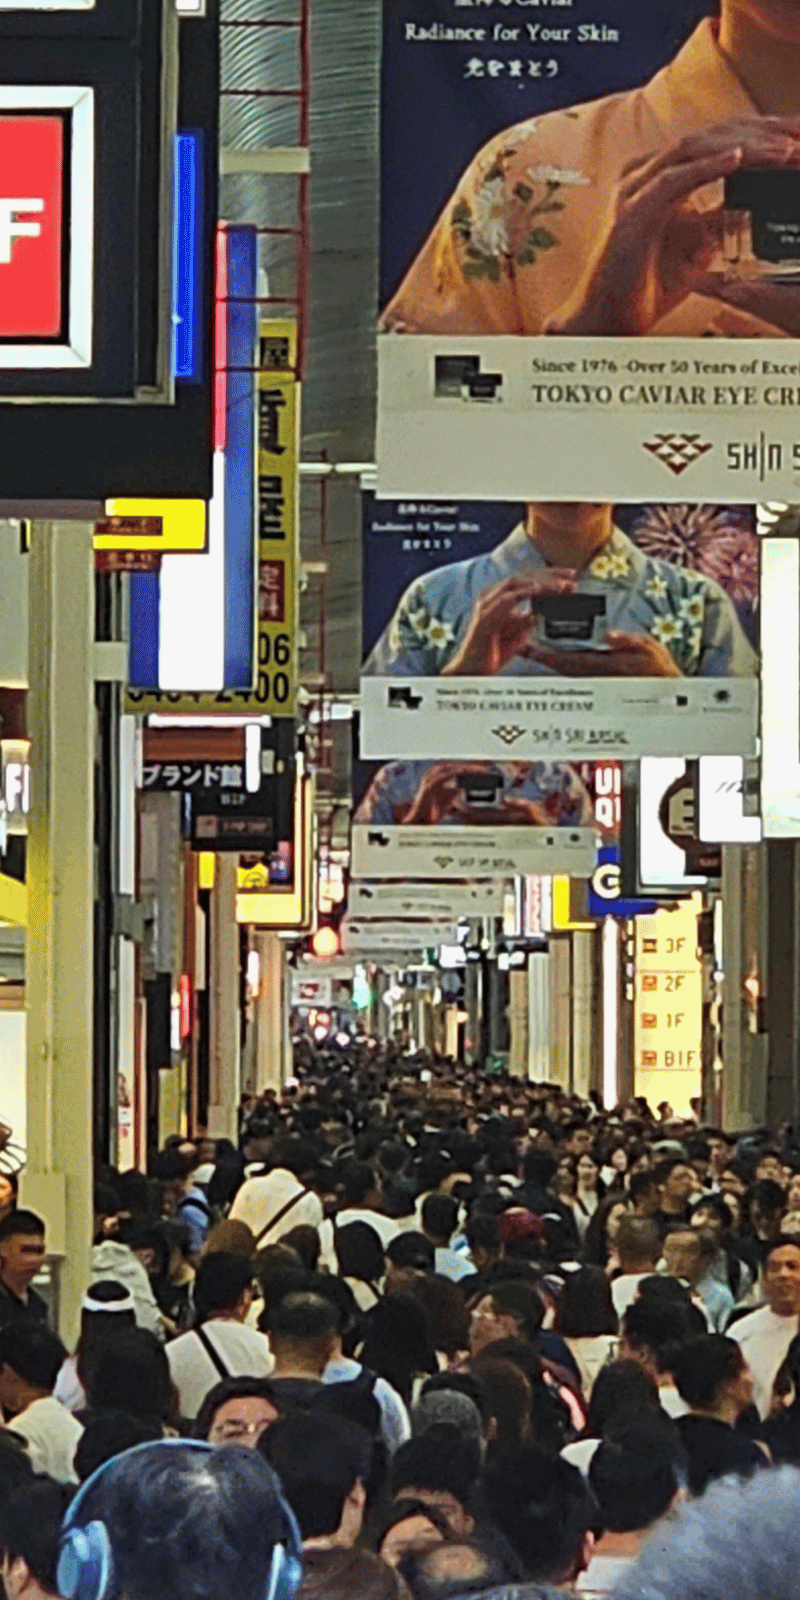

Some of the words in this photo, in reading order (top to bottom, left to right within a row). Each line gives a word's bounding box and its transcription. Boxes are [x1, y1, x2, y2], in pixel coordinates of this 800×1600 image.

[405, 23, 486, 41] Radiance
[493, 23, 520, 41] for
[527, 23, 571, 41] Your
[577, 23, 619, 42] Skin
[532, 358, 576, 374] Since
[582, 358, 617, 374] 1976
[694, 360, 736, 375] Years
[740, 359, 758, 375] of
[532, 384, 613, 404] TOKYO
[619, 384, 706, 405] CAVIAR
[713, 385, 758, 406] EYE
[665, 975, 686, 992] 2F
[666, 1012, 685, 1029] 1F
